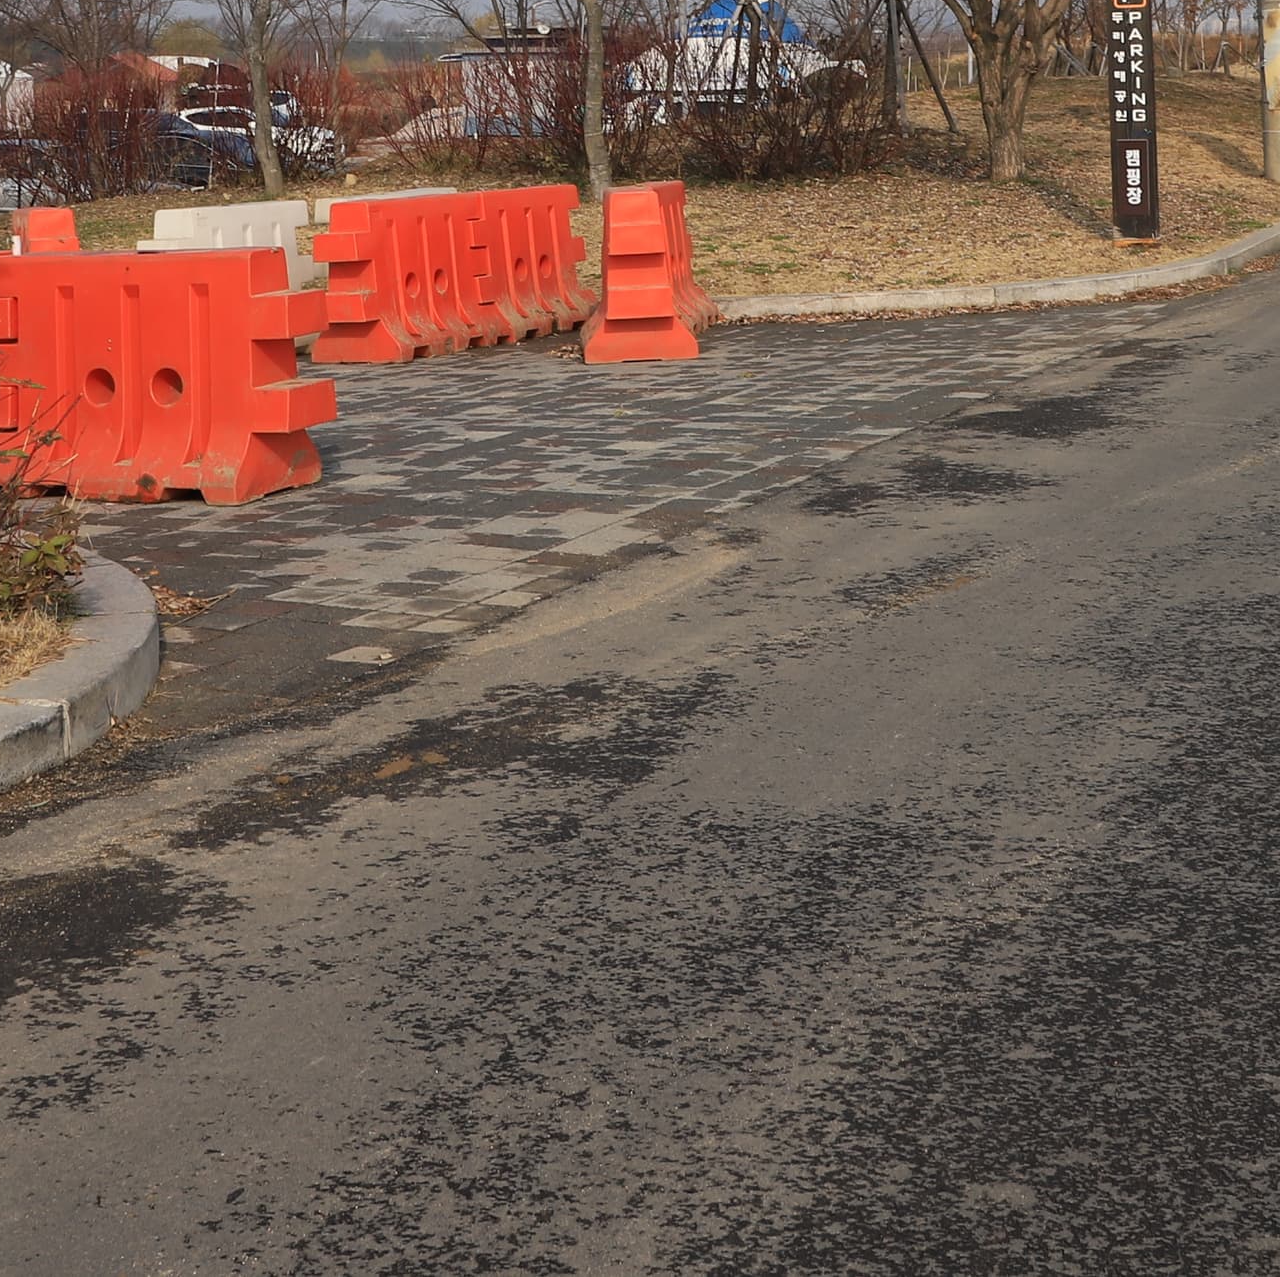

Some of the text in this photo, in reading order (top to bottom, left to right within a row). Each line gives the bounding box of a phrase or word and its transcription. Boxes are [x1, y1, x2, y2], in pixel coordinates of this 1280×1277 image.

[1111, 11, 1128, 122] 두리생태공원
[1128, 12, 1147, 122] PARKING
[1125, 149, 1142, 205] 캠핑장
